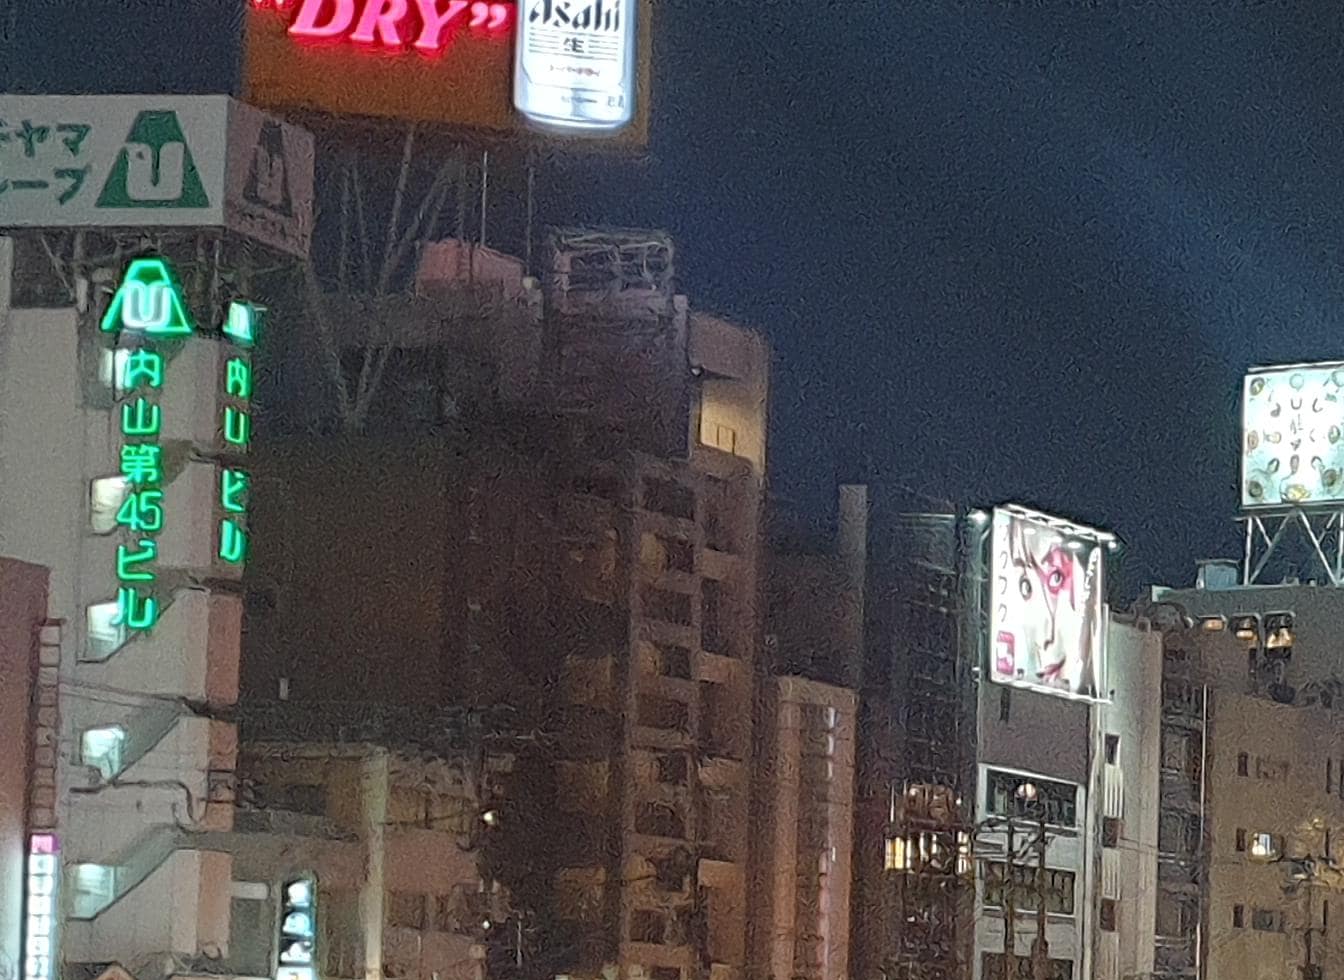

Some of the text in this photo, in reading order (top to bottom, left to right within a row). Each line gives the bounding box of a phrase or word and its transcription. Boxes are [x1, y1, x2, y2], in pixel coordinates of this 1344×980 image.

[529, 0, 620, 32] Asahi
[112, 348, 164, 630] 内山第45ビル
